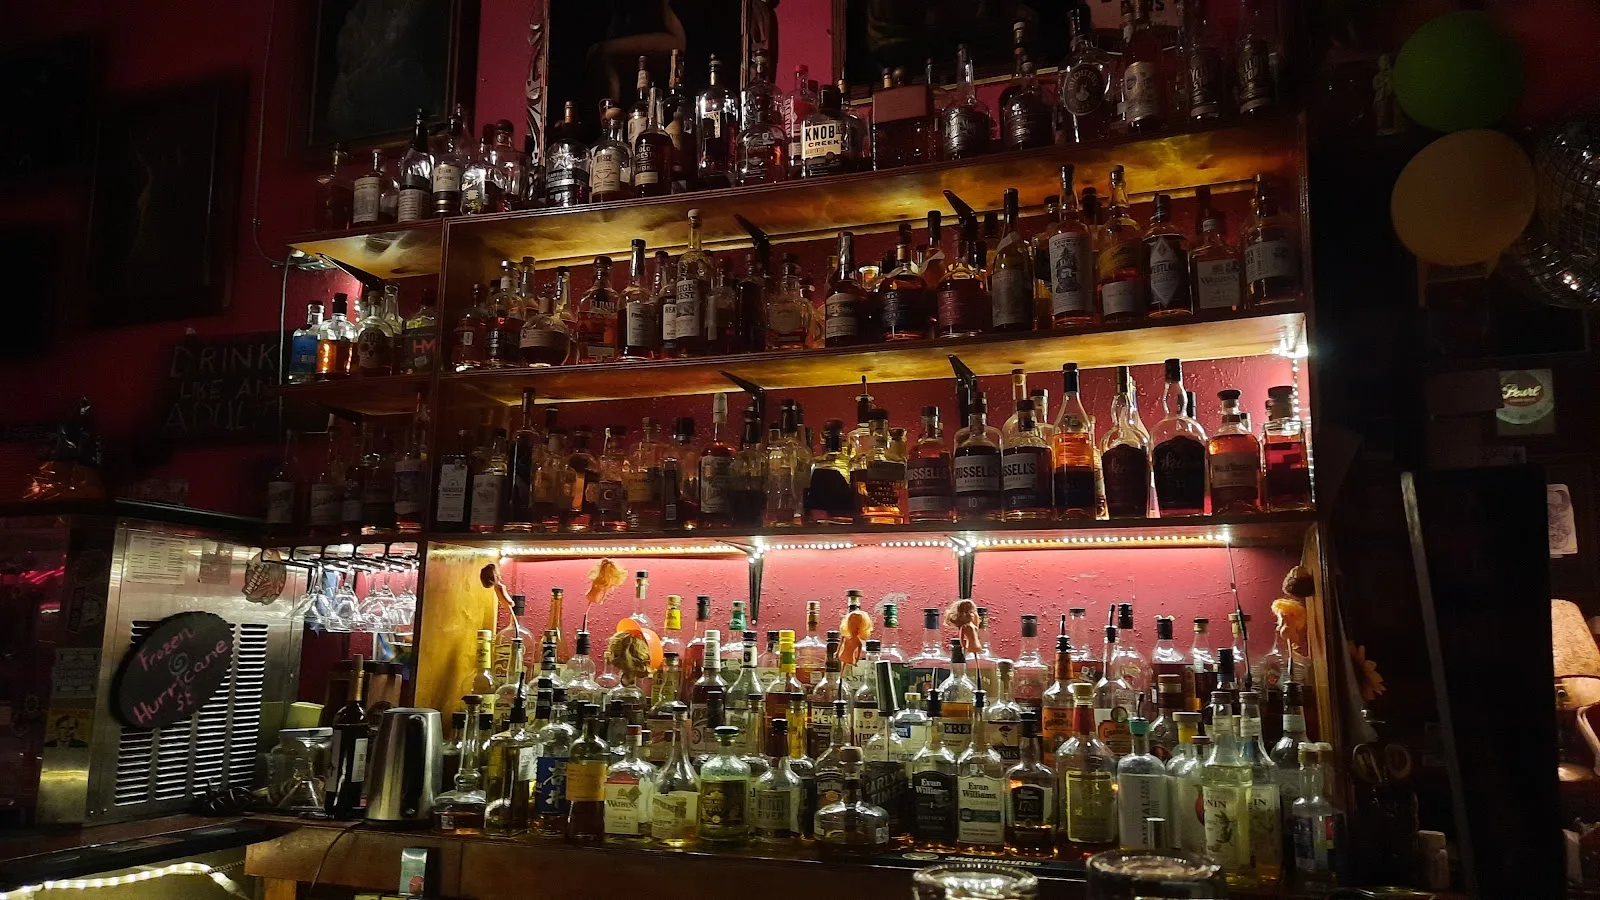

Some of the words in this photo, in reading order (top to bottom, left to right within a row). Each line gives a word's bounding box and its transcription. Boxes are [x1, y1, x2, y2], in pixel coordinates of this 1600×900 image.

[805, 125, 835, 142] KNOB
[808, 139, 840, 148] CREEK
[170, 343, 278, 378] DRINK
[1501, 383, 1542, 400] Pearl
[1003, 463, 1036, 477] SSELL'S
[137, 627, 197, 673] Frozen
[132, 639, 229, 724] Hurricane
[920, 778, 942, 787] Evan
[967, 782, 989, 790] Evan
[961, 789, 997, 799] Williams
[1206, 799, 1227, 809] NIN
